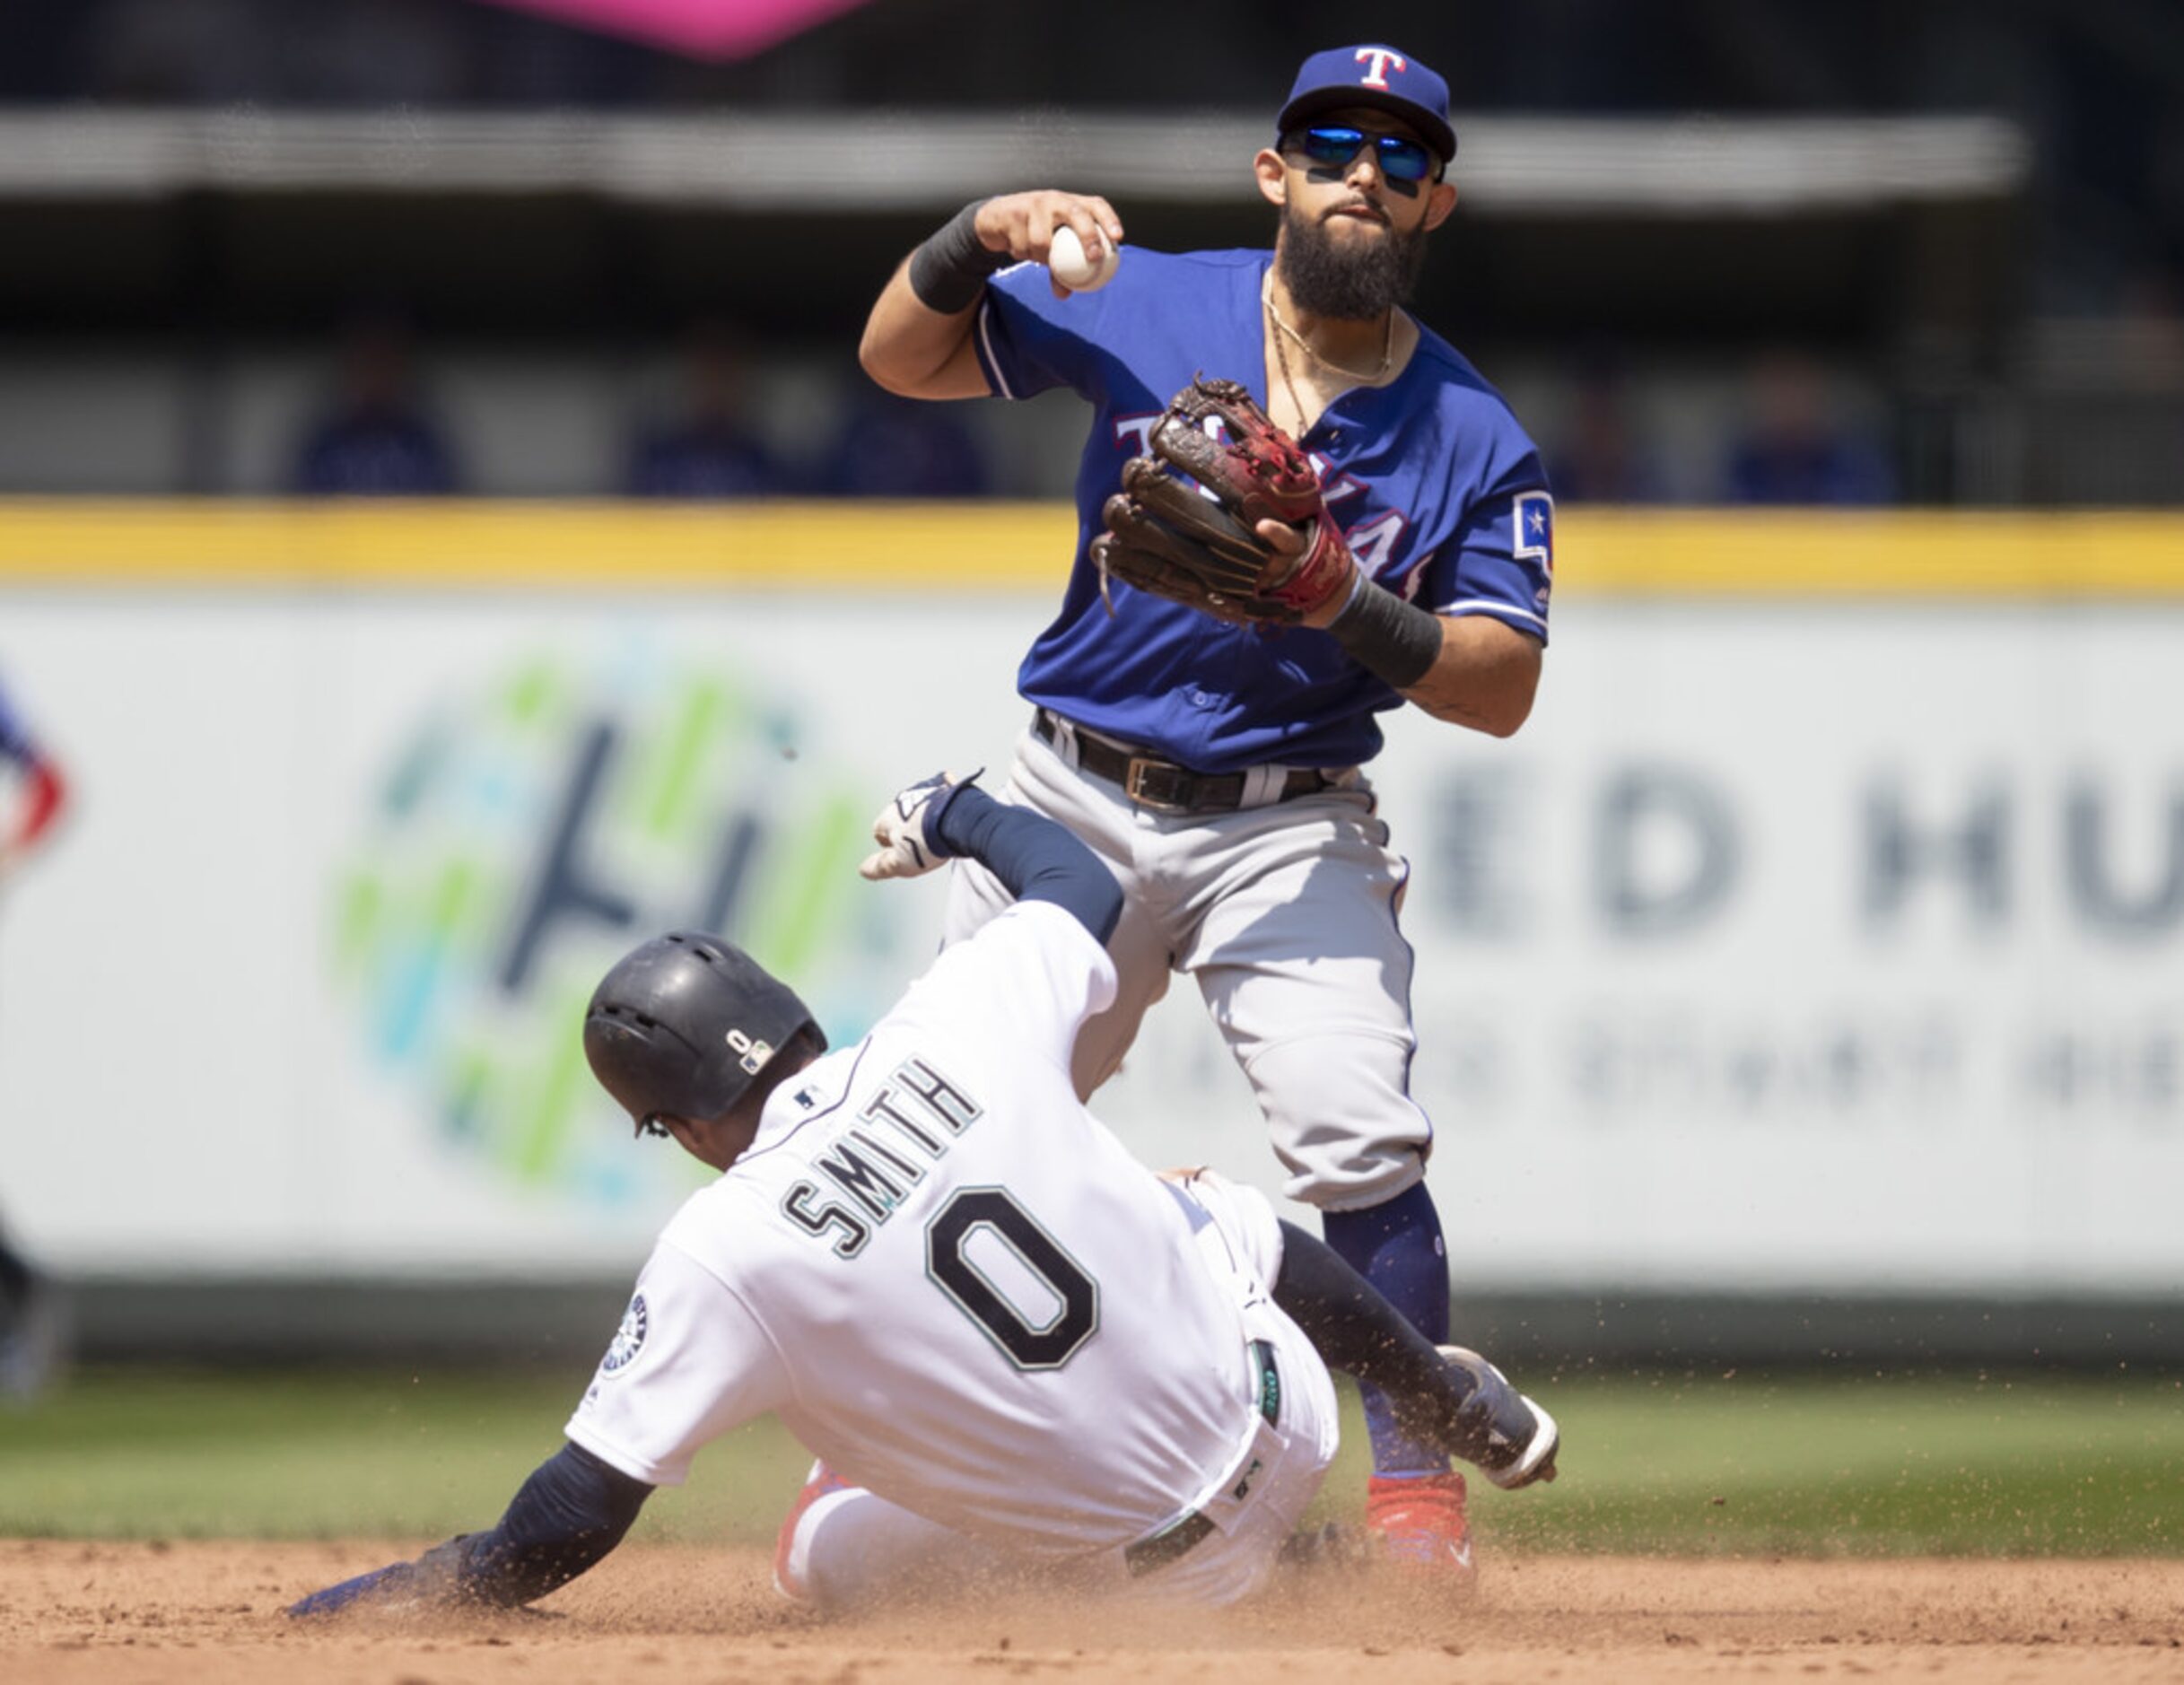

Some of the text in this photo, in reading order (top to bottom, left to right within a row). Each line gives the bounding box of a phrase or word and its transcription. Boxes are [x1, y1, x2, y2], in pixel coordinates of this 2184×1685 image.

[1355, 48, 1407, 92] T
[725, 1028, 752, 1054] 0
[781, 1052, 983, 1259] SMITH
[924, 1185, 1100, 1370] 0
